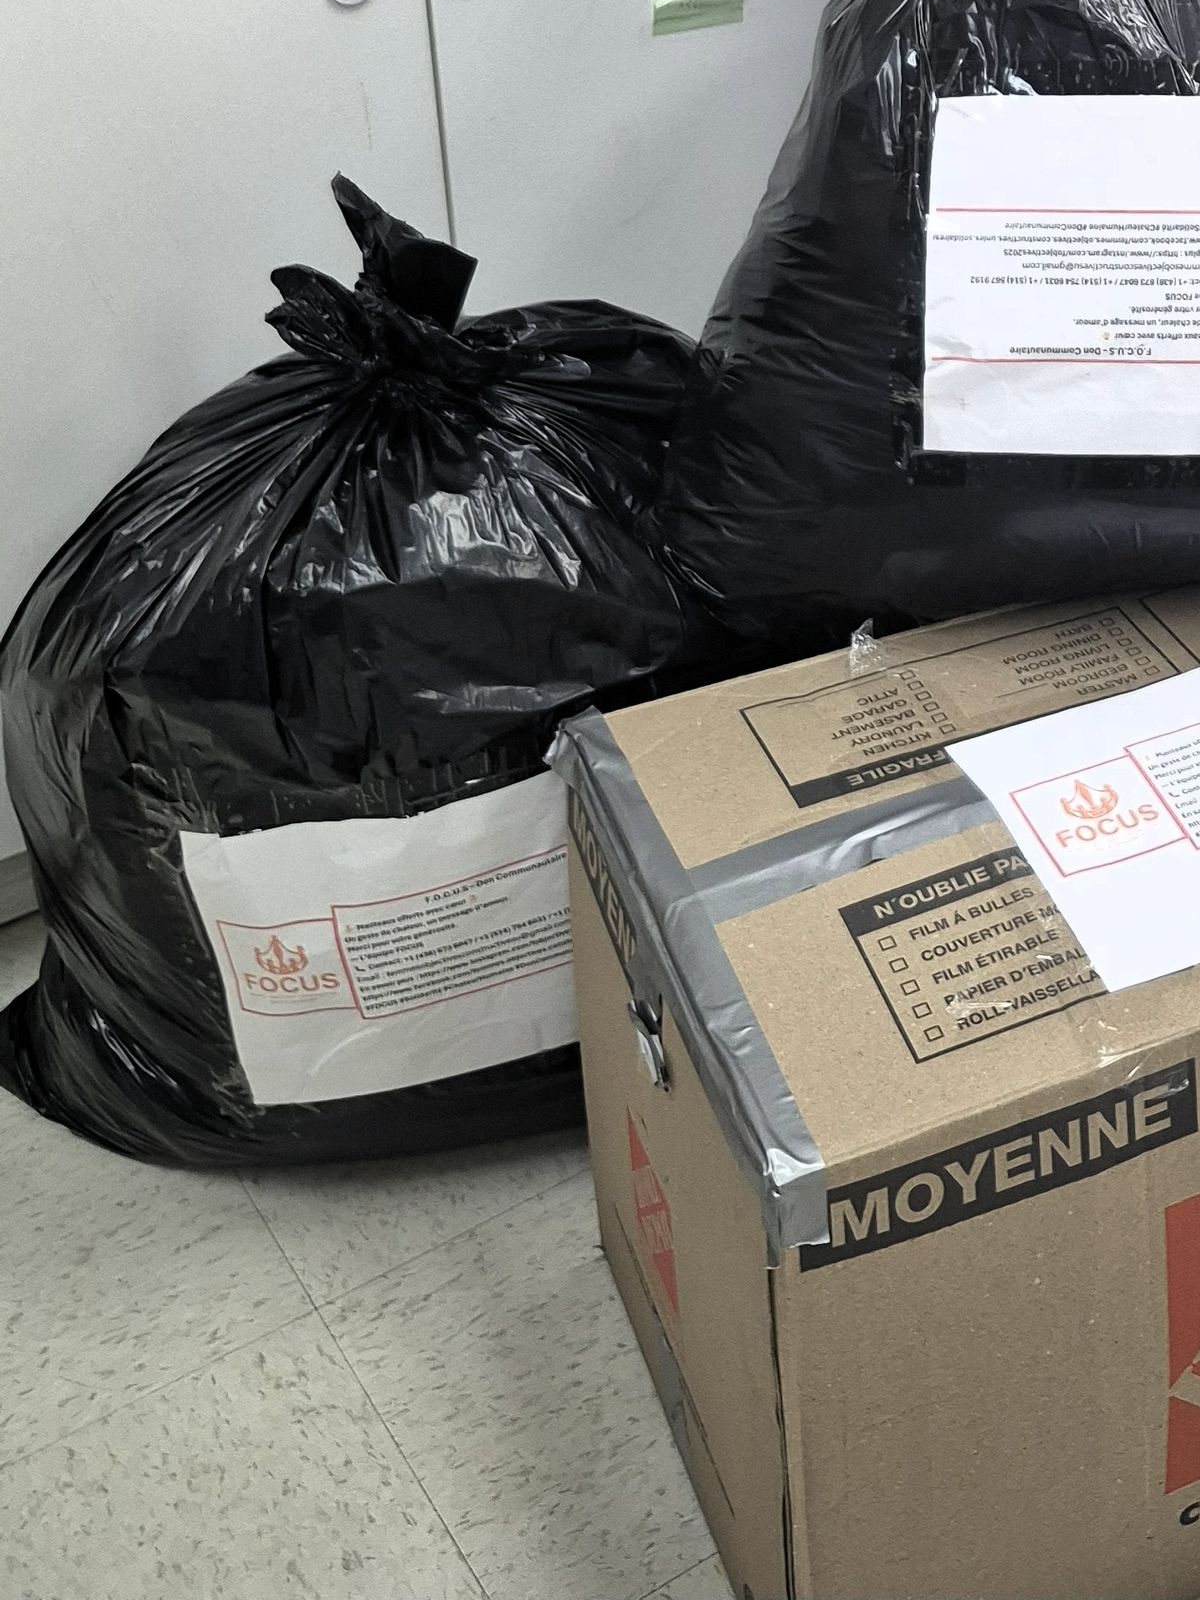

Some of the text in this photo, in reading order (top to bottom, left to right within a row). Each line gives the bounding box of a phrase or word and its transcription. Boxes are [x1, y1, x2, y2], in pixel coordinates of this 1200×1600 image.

[1165, 292, 1193, 300] FOCUS
[1110, 317, 1145, 325] message
[1009, 345, 1152, 356] F.O.C.U.S Don Communautaire
[1156, 332, 1183, 341] offerts
[1054, 623, 1092, 639] BATH
[1002, 632, 1101, 665] DINING ROOM
[1014, 643, 1110, 674] LIVING ROOM
[1019, 653, 1120, 686] FAMILY ROOM
[1051, 663, 1129, 690] BEDROOM
[1075, 672, 1138, 696] MASTER
[856, 687, 899, 706] ATTIC
[831, 709, 916, 741] BASEMENT
[840, 699, 908, 724] GARAGE
[850, 720, 925, 748] LAUNDRY
[861, 731, 933, 757] KITCHEN
[845, 750, 946, 786] FRAGILE
[1054, 803, 1160, 848] FOCUS
[873, 855, 1029, 920] N'OUBLIE PA
[909, 917, 951, 941] FILM
[968, 887, 1035, 921] BULLES
[920, 910, 1038, 962] COUVERTURE
[931, 928, 1060, 985] FILM ÉTIRABLE
[243, 971, 341, 994] FOCUS
[943, 948, 1088, 1006] PAPIER D'EMBAL
[829, 1083, 1172, 1248] MOYENNE
